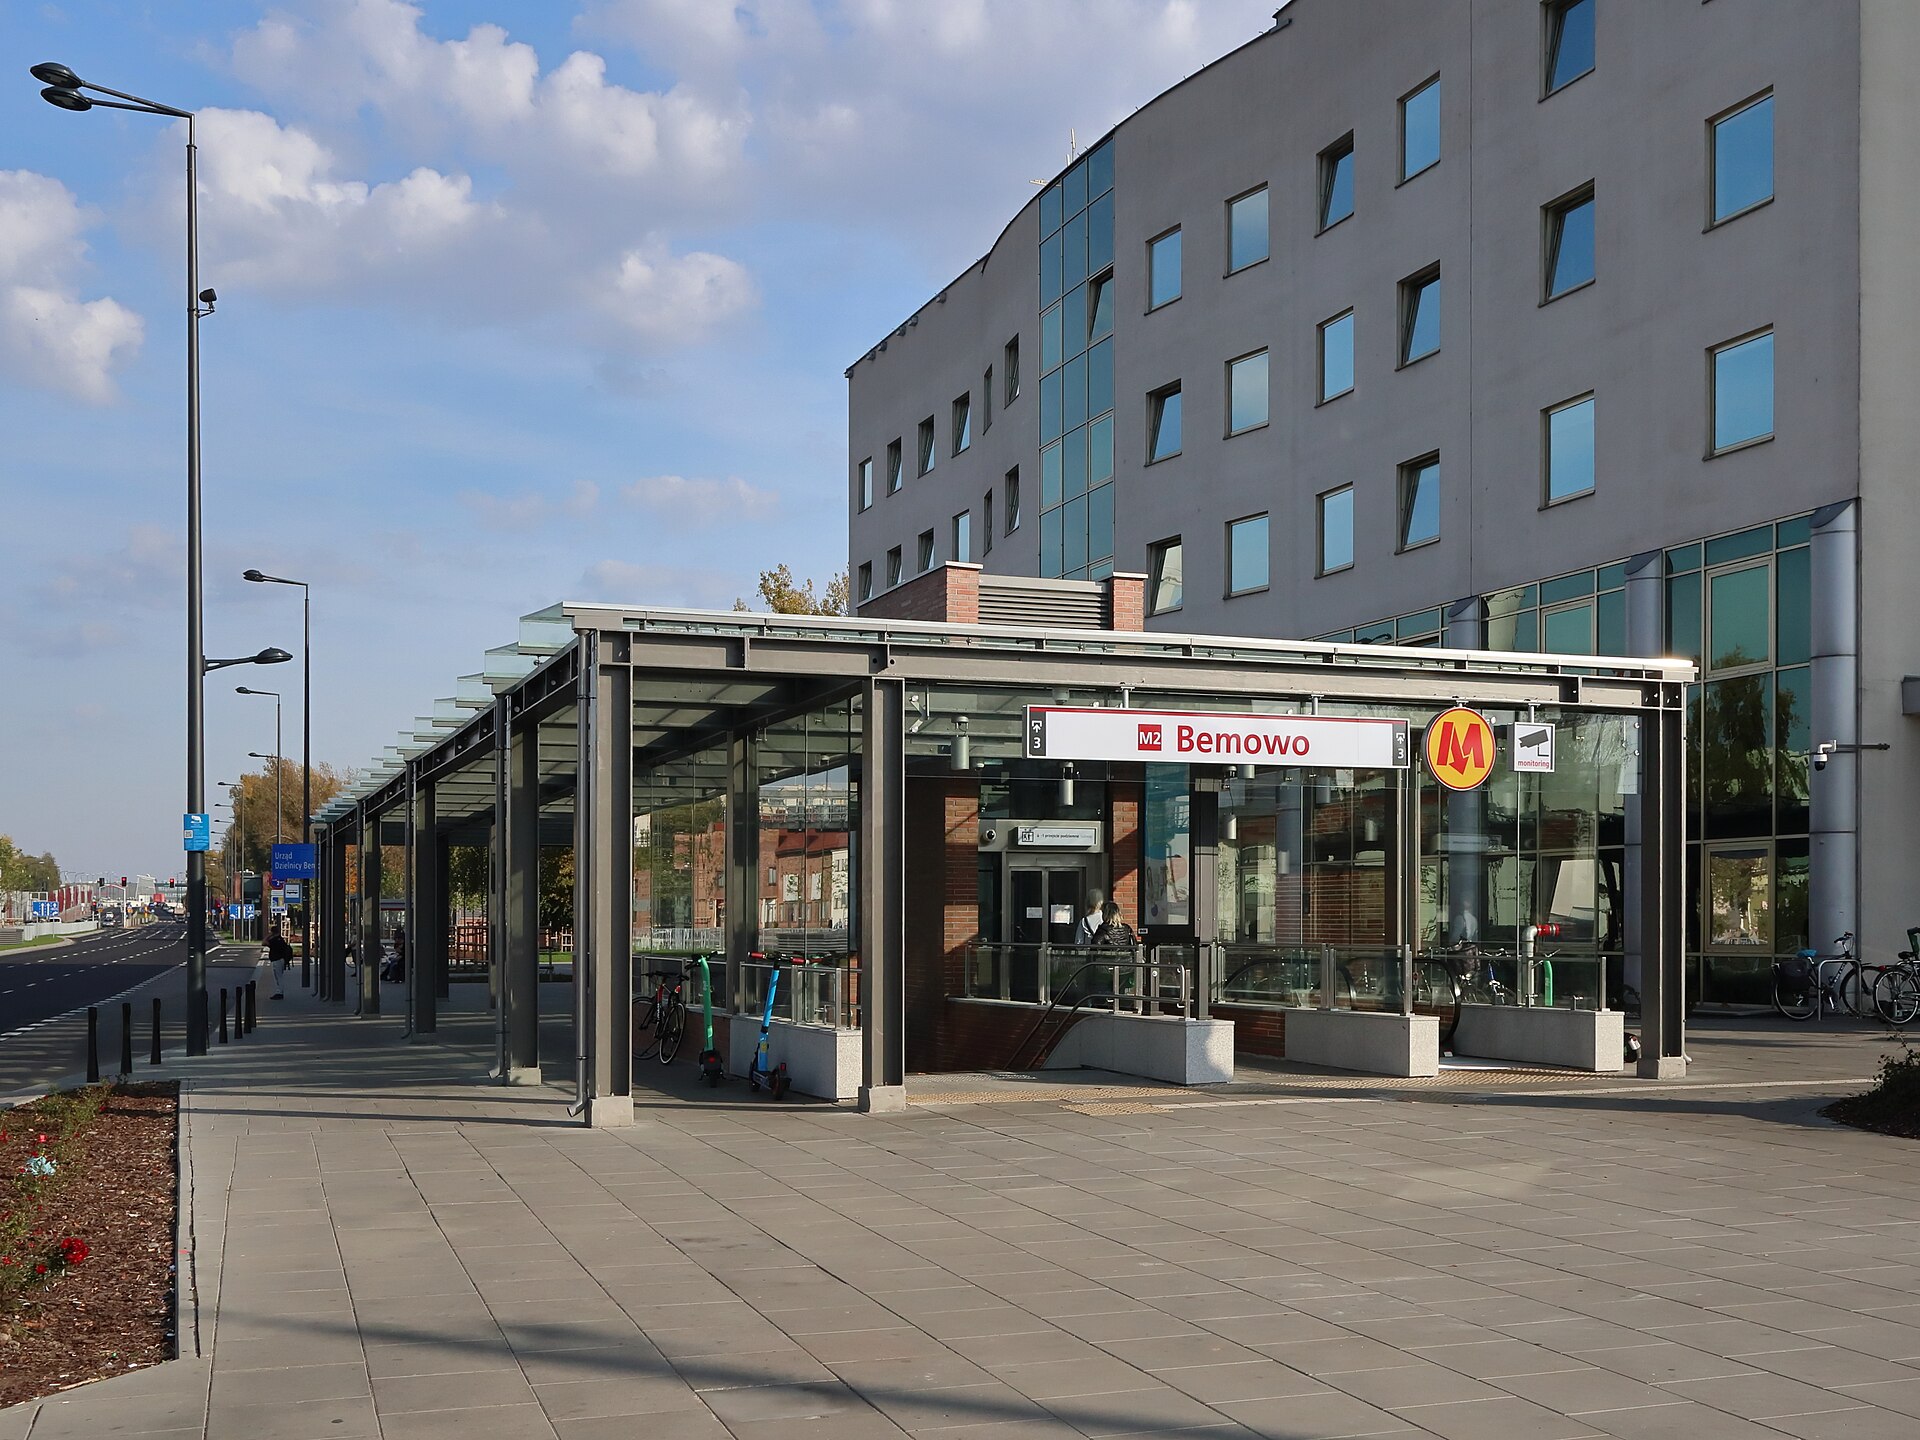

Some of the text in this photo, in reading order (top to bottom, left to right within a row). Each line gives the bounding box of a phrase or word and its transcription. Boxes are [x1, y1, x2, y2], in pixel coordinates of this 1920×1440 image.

[1033, 737, 1041, 749] 3
[1139, 725, 1310, 756] M2 Bemowo
[1397, 748, 1404, 759] 3
[1517, 759, 1550, 769] monitoring
[274, 851, 293, 860] Urząd
[274, 861, 302, 871] Dzielnicy
